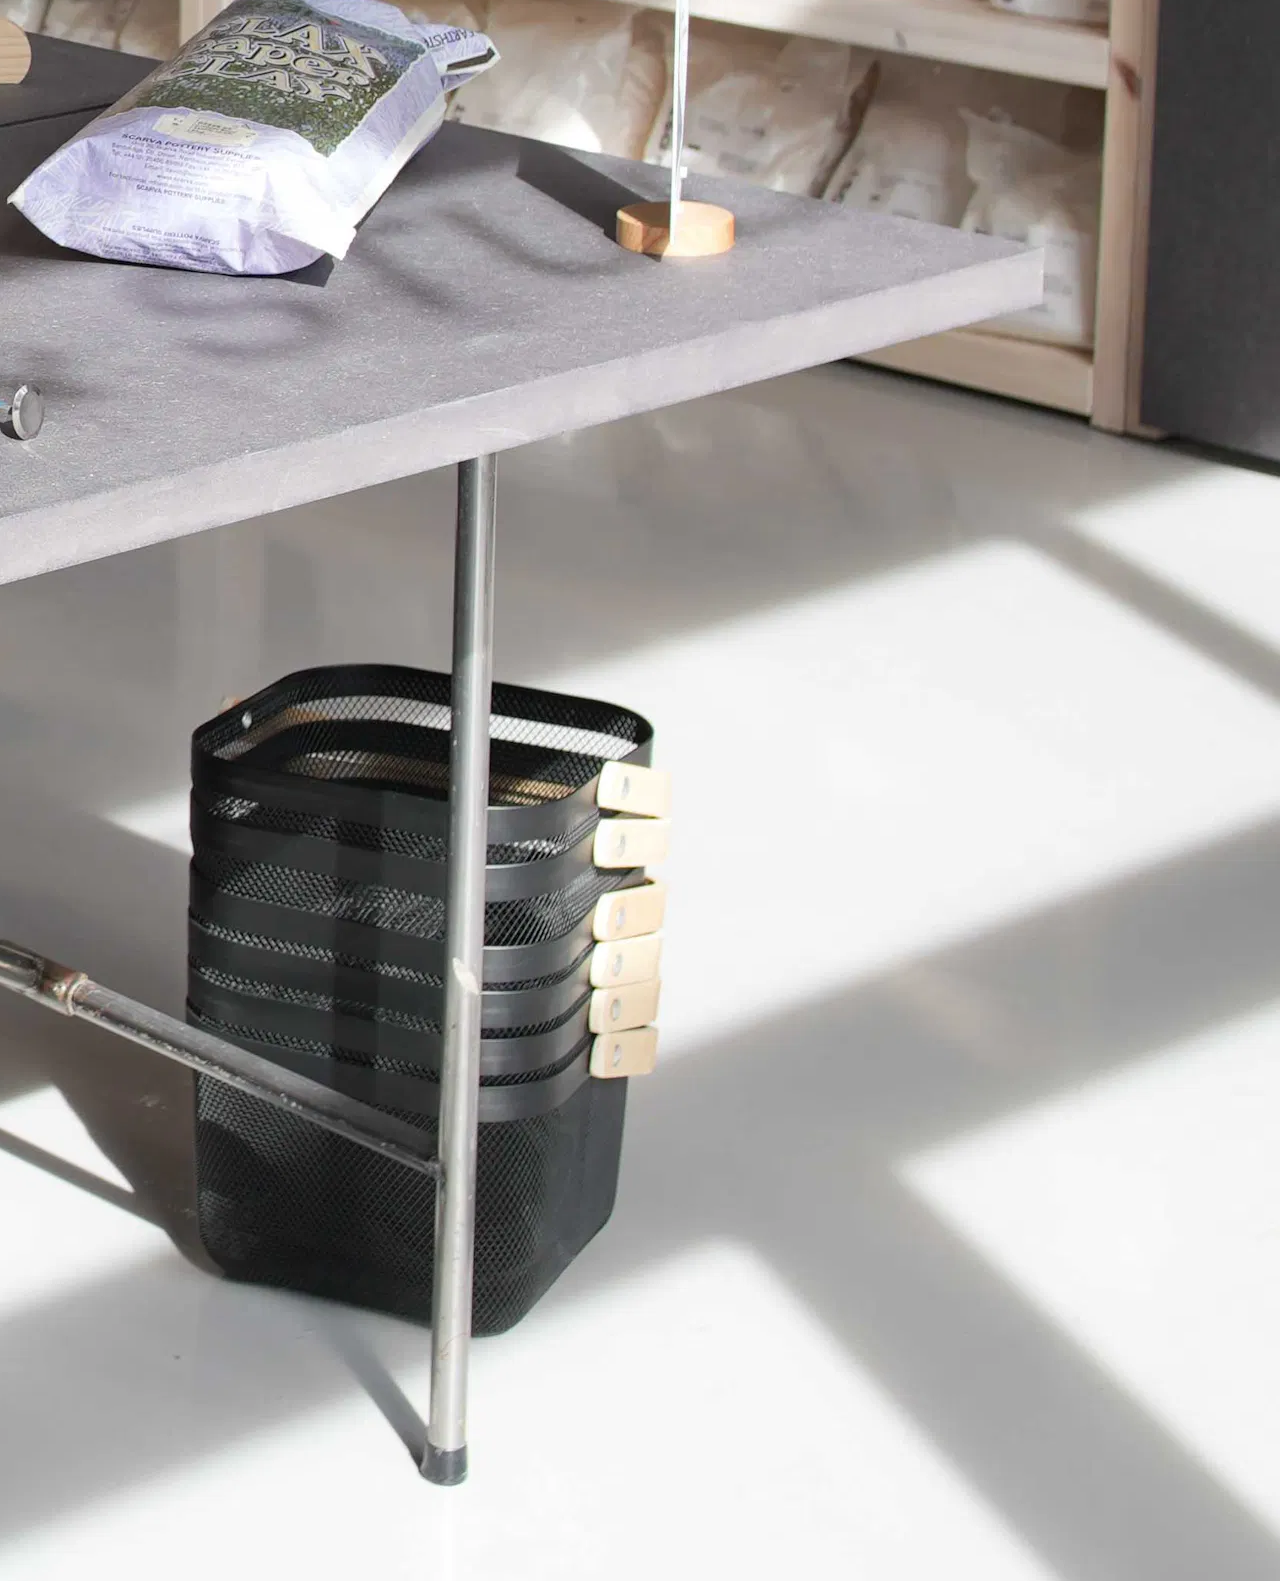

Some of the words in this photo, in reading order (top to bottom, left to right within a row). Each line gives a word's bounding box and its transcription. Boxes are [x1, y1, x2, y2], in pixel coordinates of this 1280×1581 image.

[122, 133, 162, 145] SCARVA
[164, 141, 211, 152] POTTERY
[136, 184, 162, 194] SCARVA
[164, 189, 193, 199] POTTERY
[164, 230, 194, 240] POTTERY
